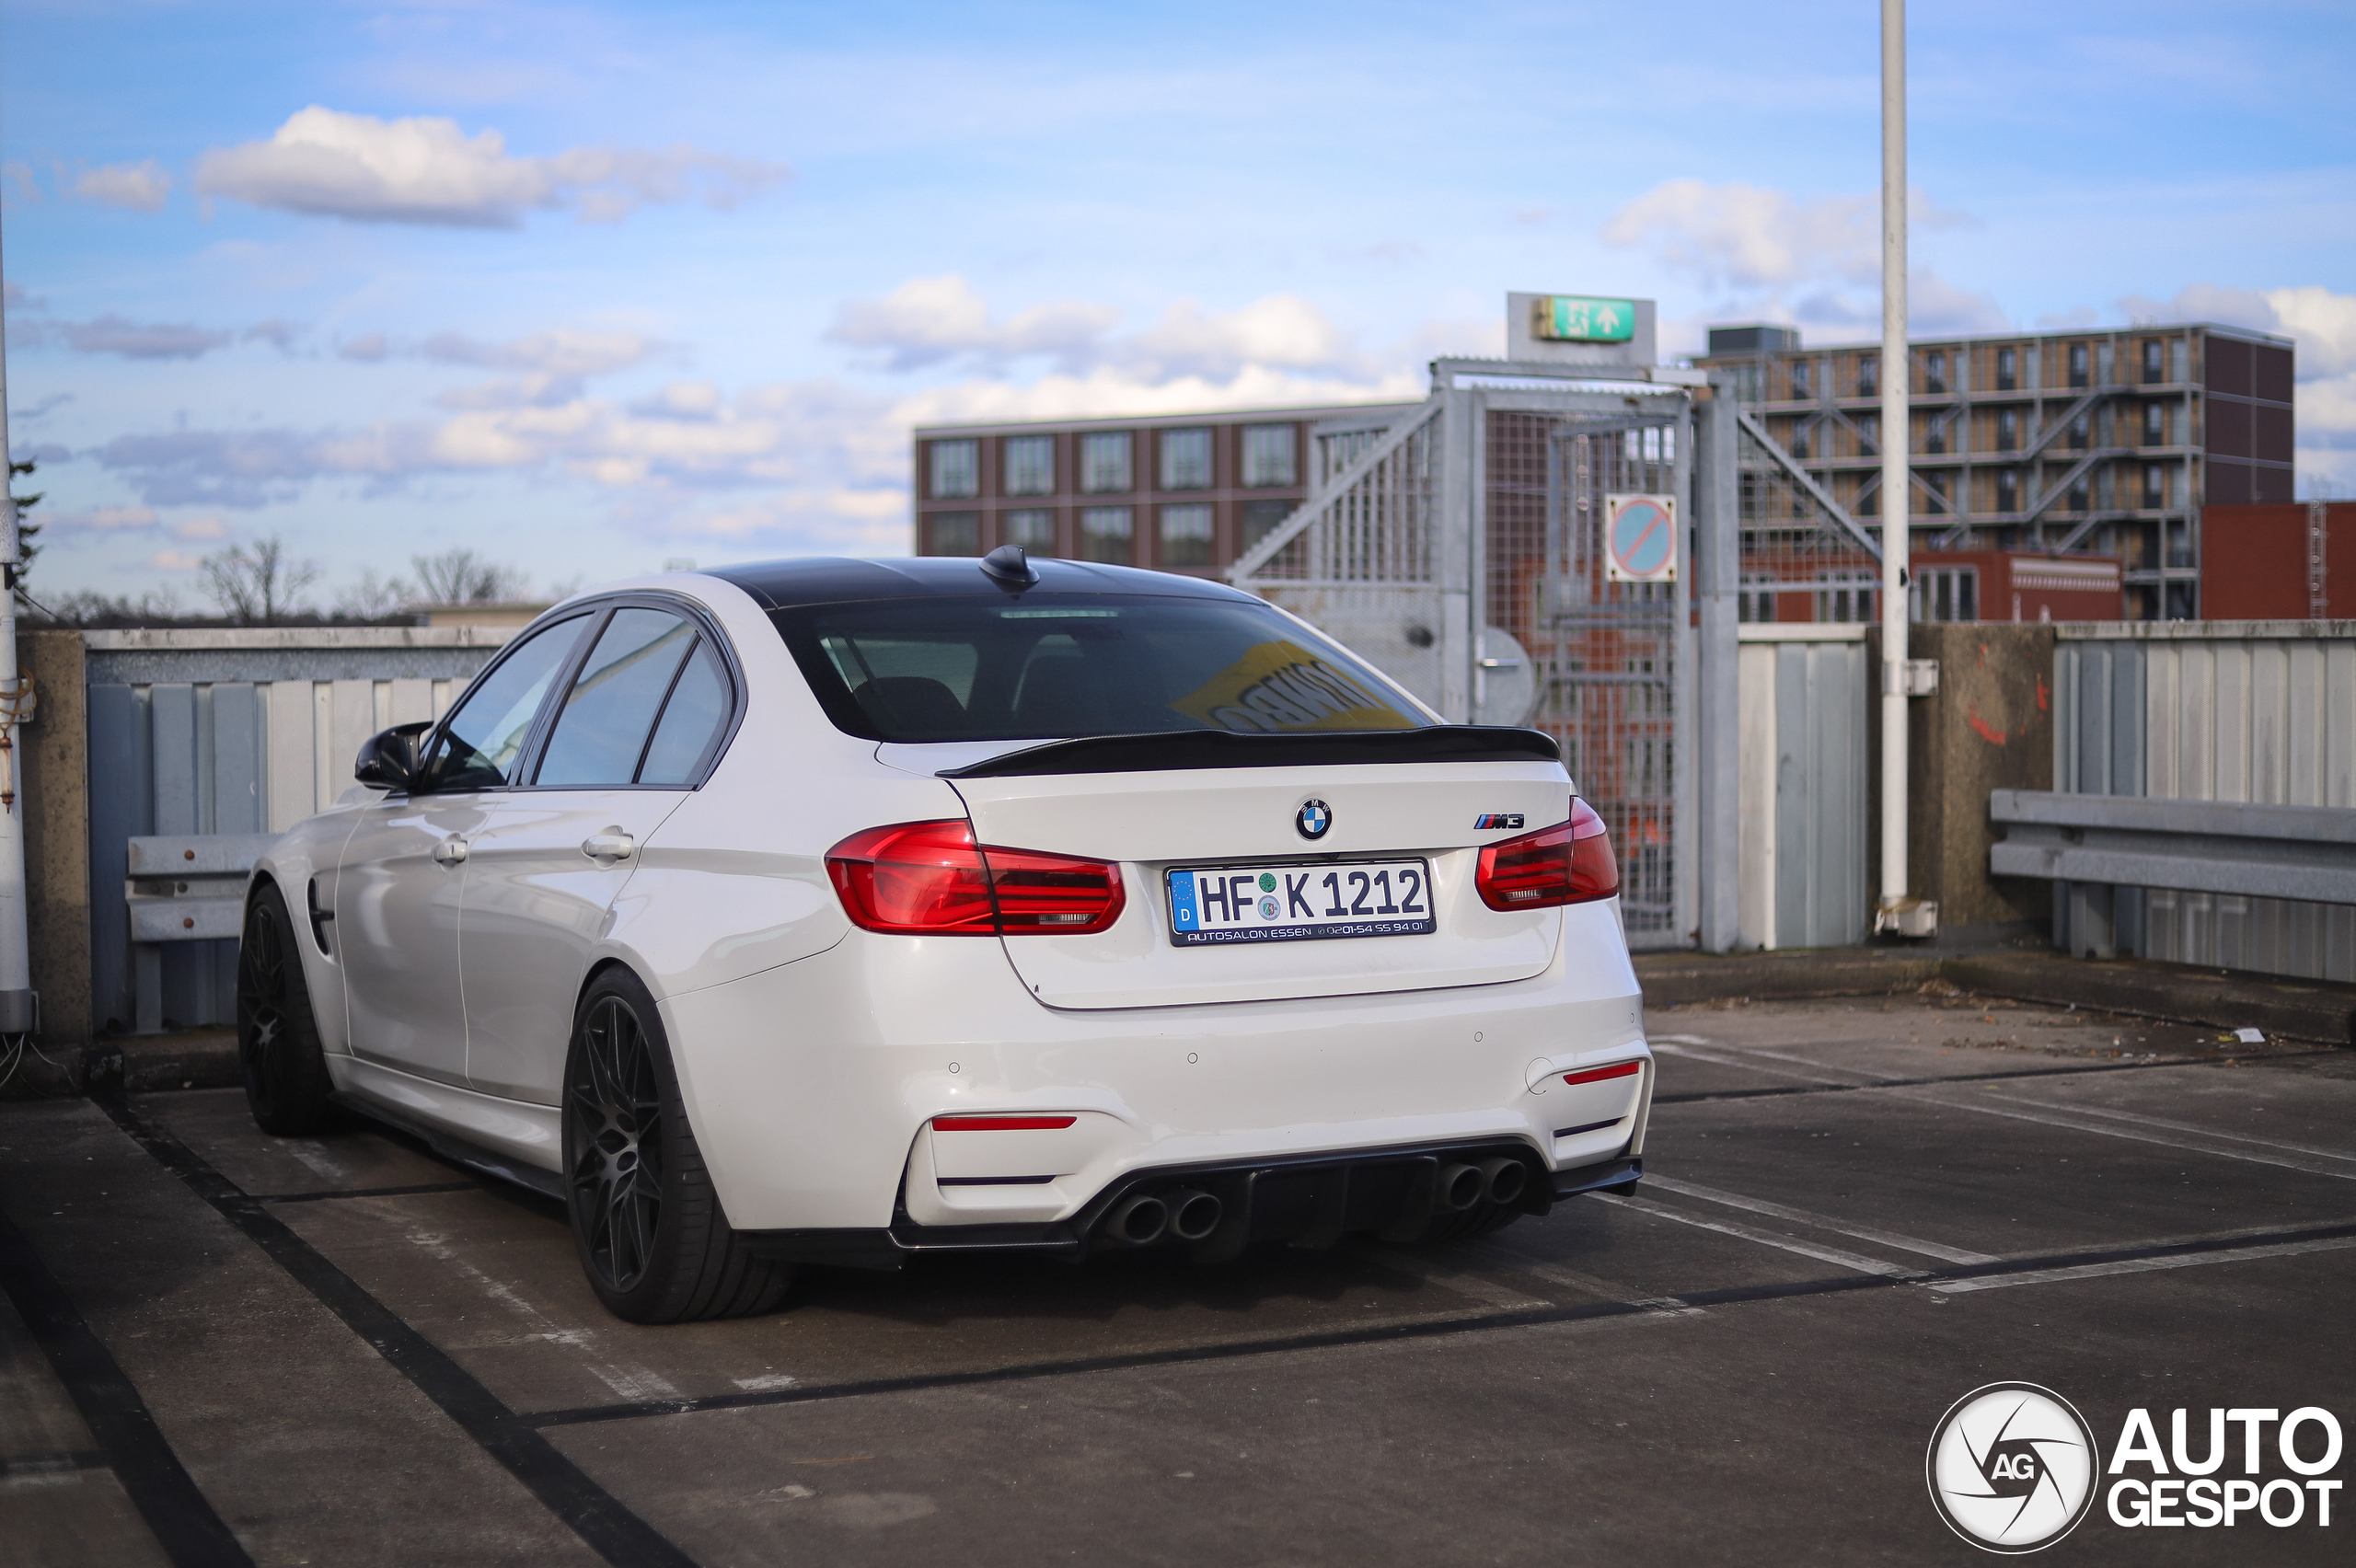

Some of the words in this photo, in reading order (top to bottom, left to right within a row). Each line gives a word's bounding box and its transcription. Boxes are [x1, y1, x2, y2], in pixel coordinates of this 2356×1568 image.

[1299, 800, 1330, 813] BMW
[1474, 813, 1524, 829] M3
[1199, 875, 1254, 922] HF
[1285, 872, 1315, 918] K
[1322, 869, 1425, 917] 1212
[1181, 908, 1191, 922] D
[1187, 929, 1267, 942] AUTOSALON
[1270, 928, 1311, 938] ESSEN
[1392, 922, 1409, 931] 94
[1412, 921, 1424, 930] 01
